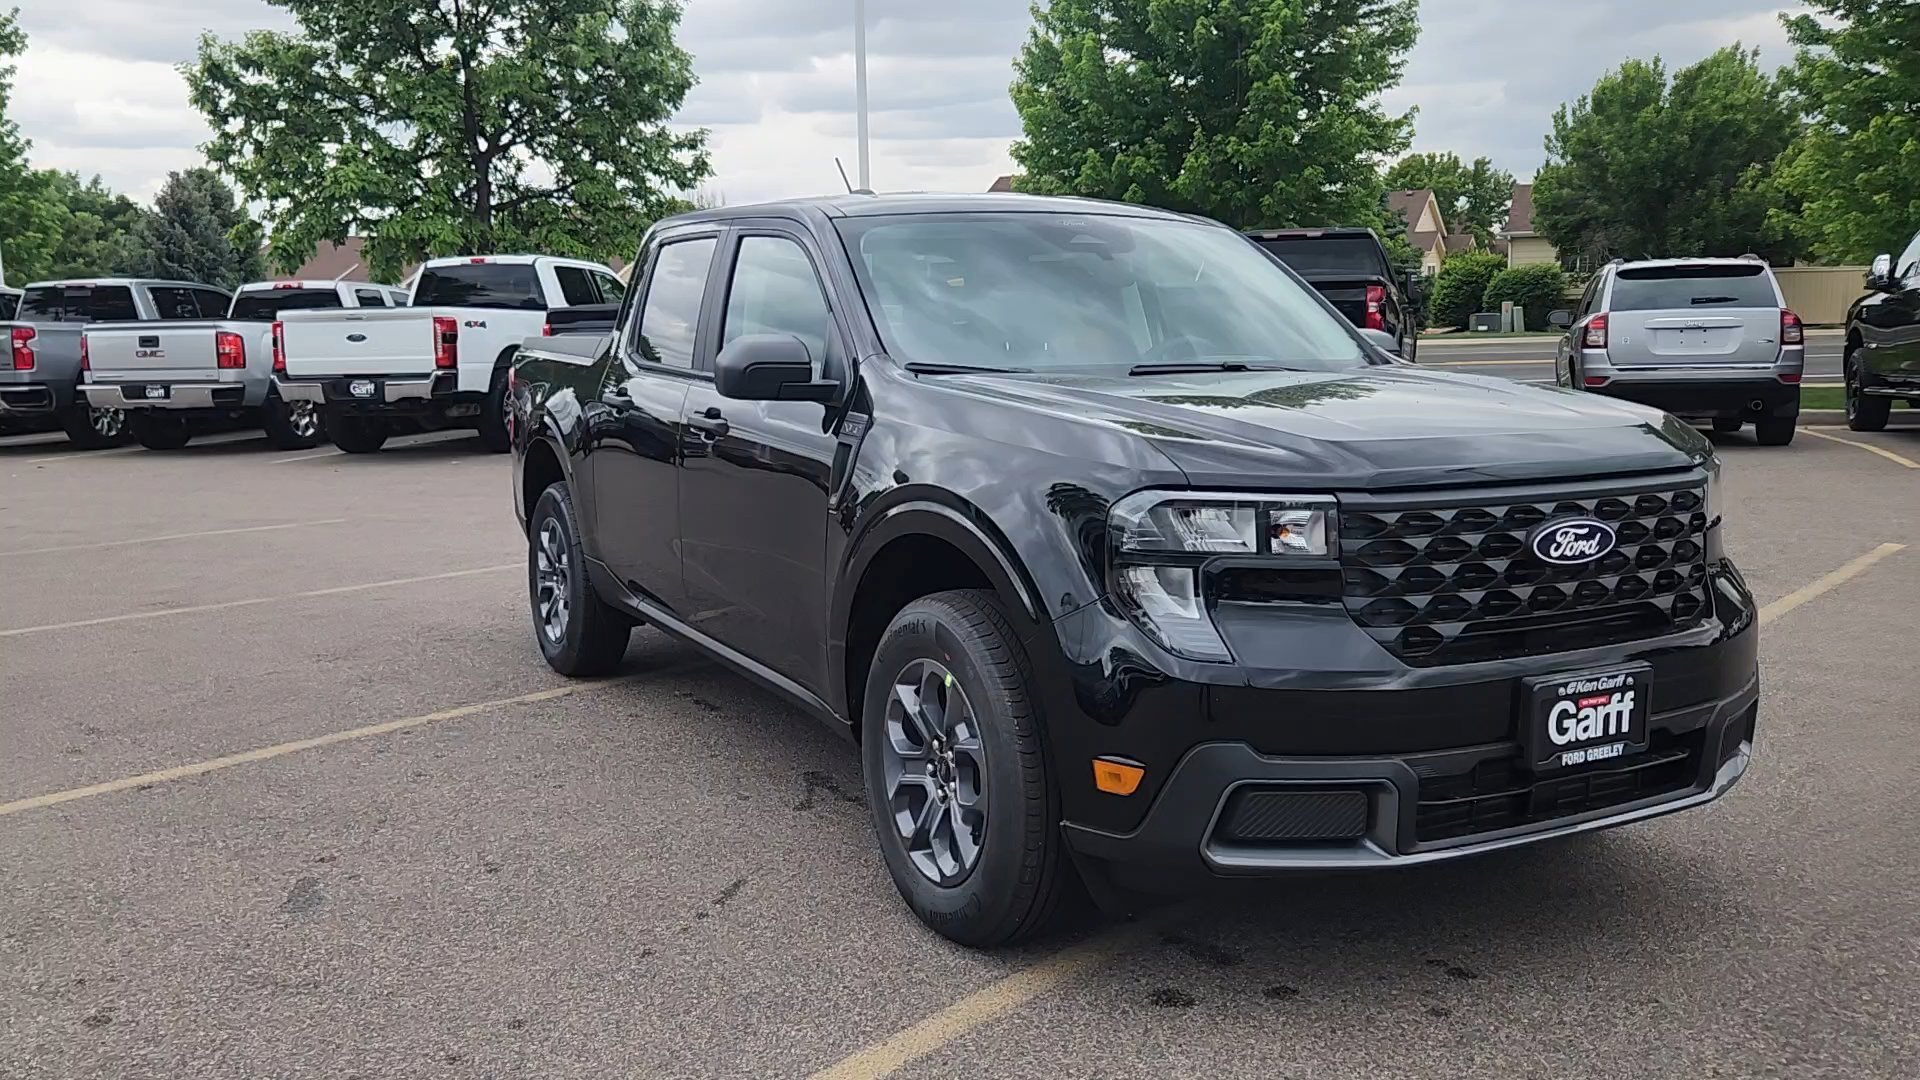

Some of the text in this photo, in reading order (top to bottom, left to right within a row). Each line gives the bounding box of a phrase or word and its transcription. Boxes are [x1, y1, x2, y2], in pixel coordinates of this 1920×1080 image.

[135, 350, 165, 358] GMC
[145, 387, 165, 398] Garff
[350, 383, 375, 395] Garff
[1549, 527, 1601, 558] Ford
[1575, 679, 1598, 694] Ken
[1597, 673, 1626, 690] Garff
[1547, 690, 1635, 746] Garff
[1561, 743, 1625, 767] FORD GREELEY
